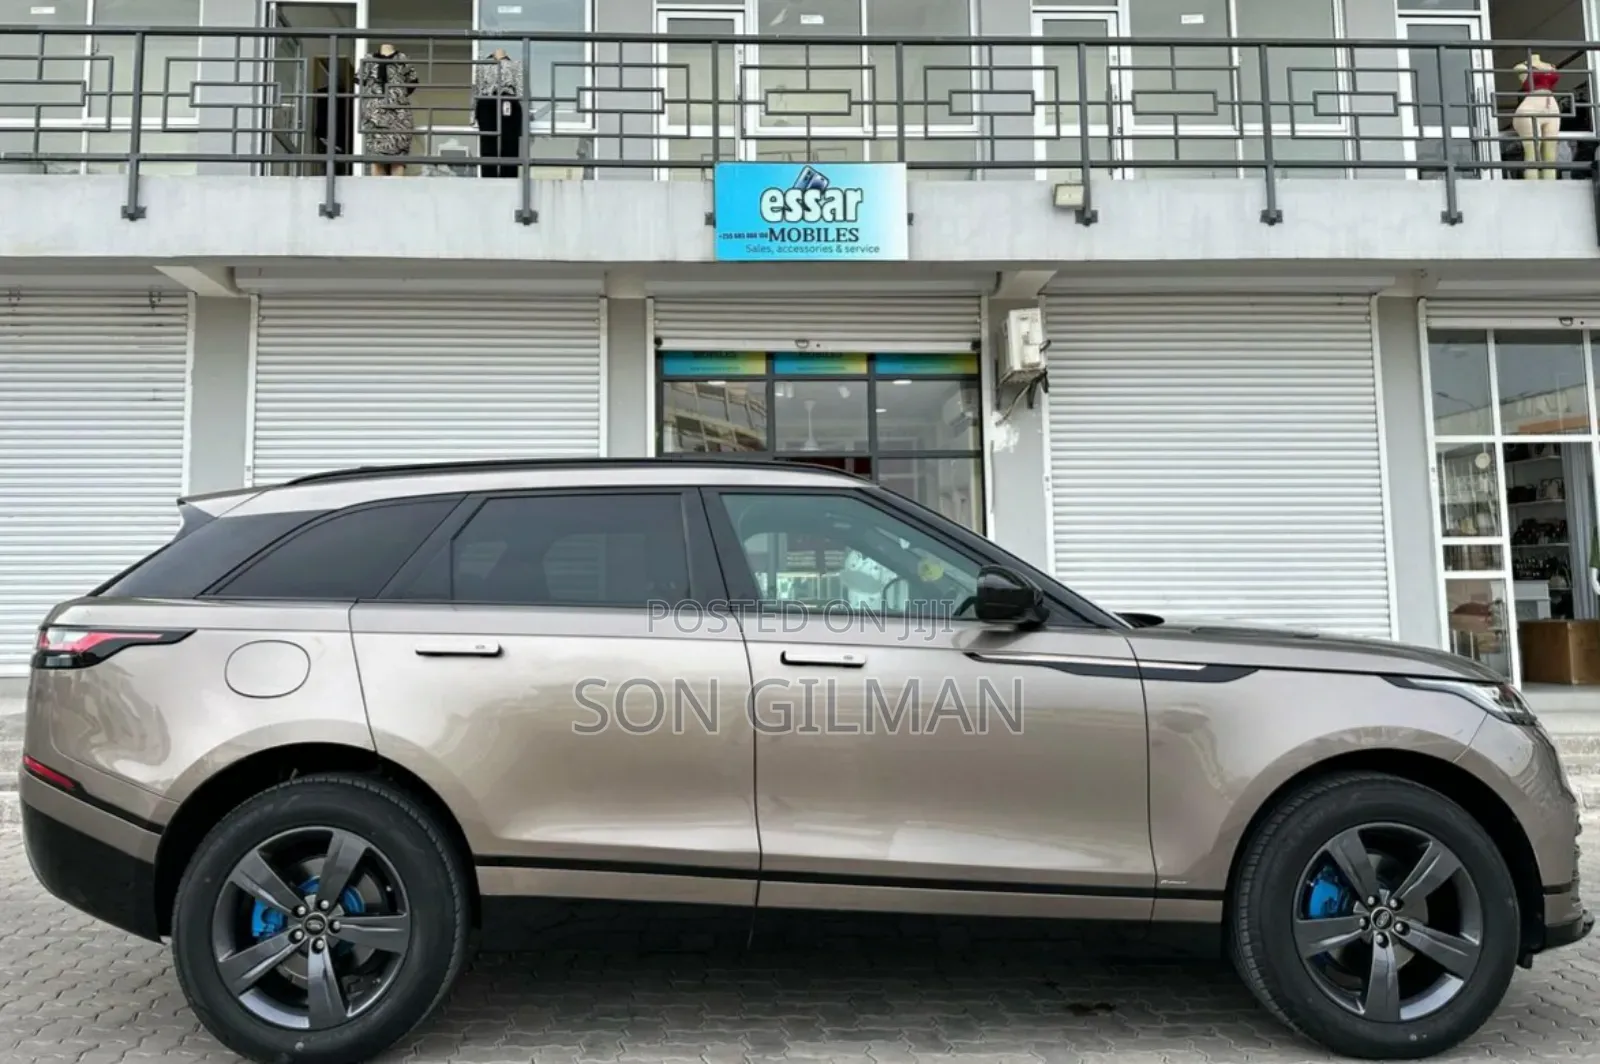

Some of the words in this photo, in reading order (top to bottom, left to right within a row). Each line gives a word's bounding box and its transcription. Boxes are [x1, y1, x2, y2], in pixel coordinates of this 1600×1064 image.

[760, 187, 863, 223] essar
[768, 227, 860, 243] MOBILES
[745, 244, 774, 255] Sales,
[776, 245, 833, 254] accessories
[835, 244, 842, 253] &
[845, 244, 880, 253] service
